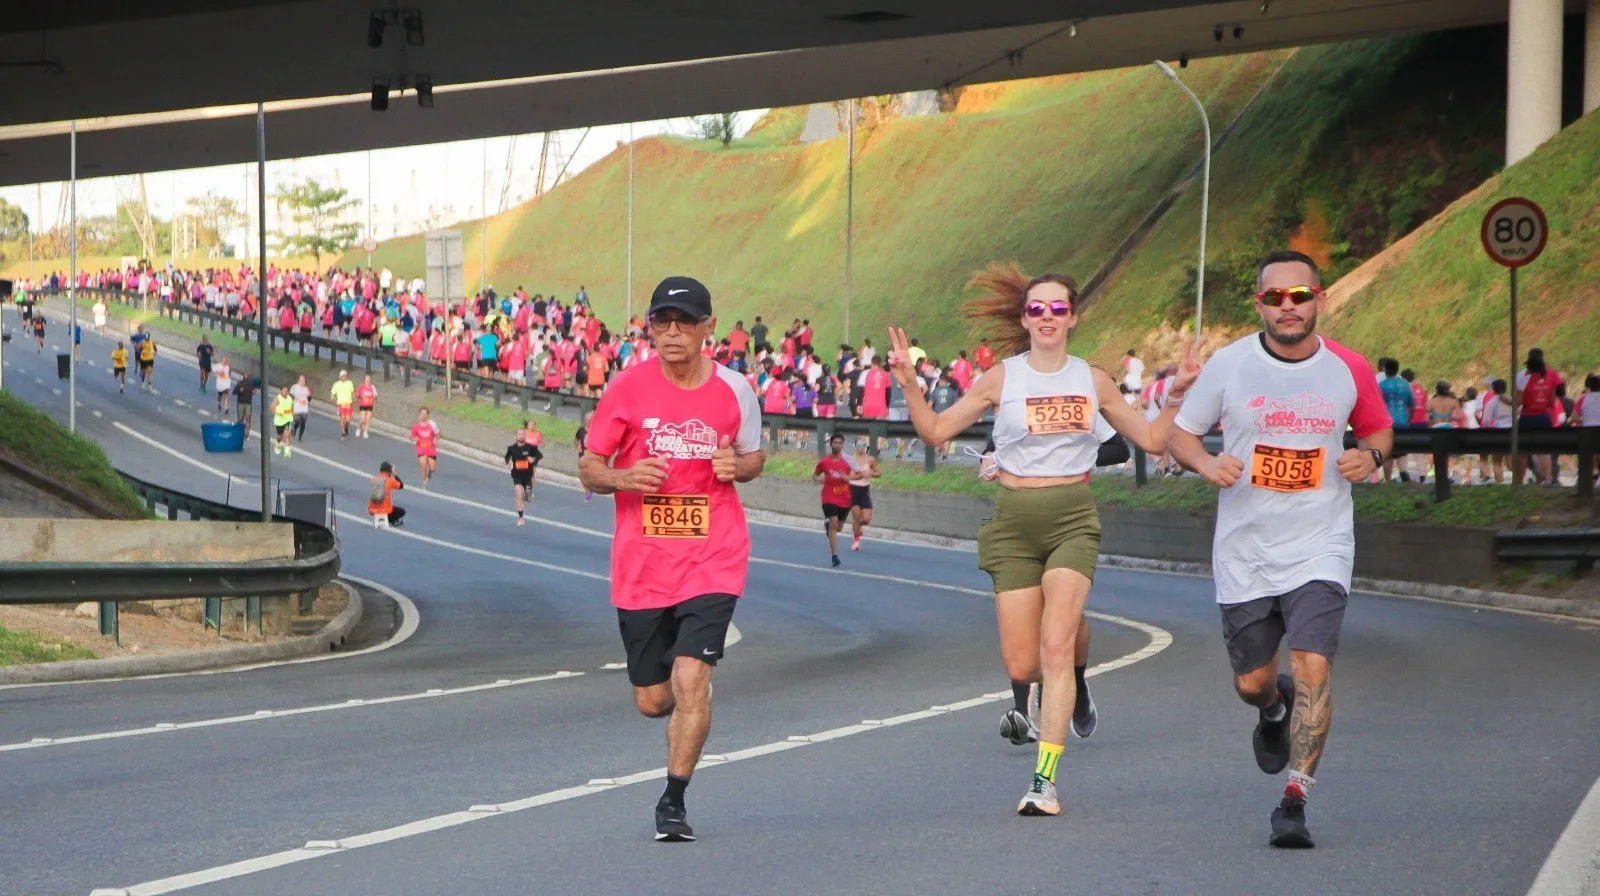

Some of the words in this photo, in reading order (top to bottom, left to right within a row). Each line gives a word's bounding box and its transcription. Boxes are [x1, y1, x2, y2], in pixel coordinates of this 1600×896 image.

[1495, 217, 1535, 243] 80
[1035, 405, 1084, 422] 5258
[1265, 411, 1296, 421] MEIA
[1265, 417, 1336, 428] MARATONA
[654, 440, 718, 454] MARATONA
[656, 435, 683, 445] MEIA
[1261, 457, 1312, 479] 5058
[651, 507, 702, 526] 6846
